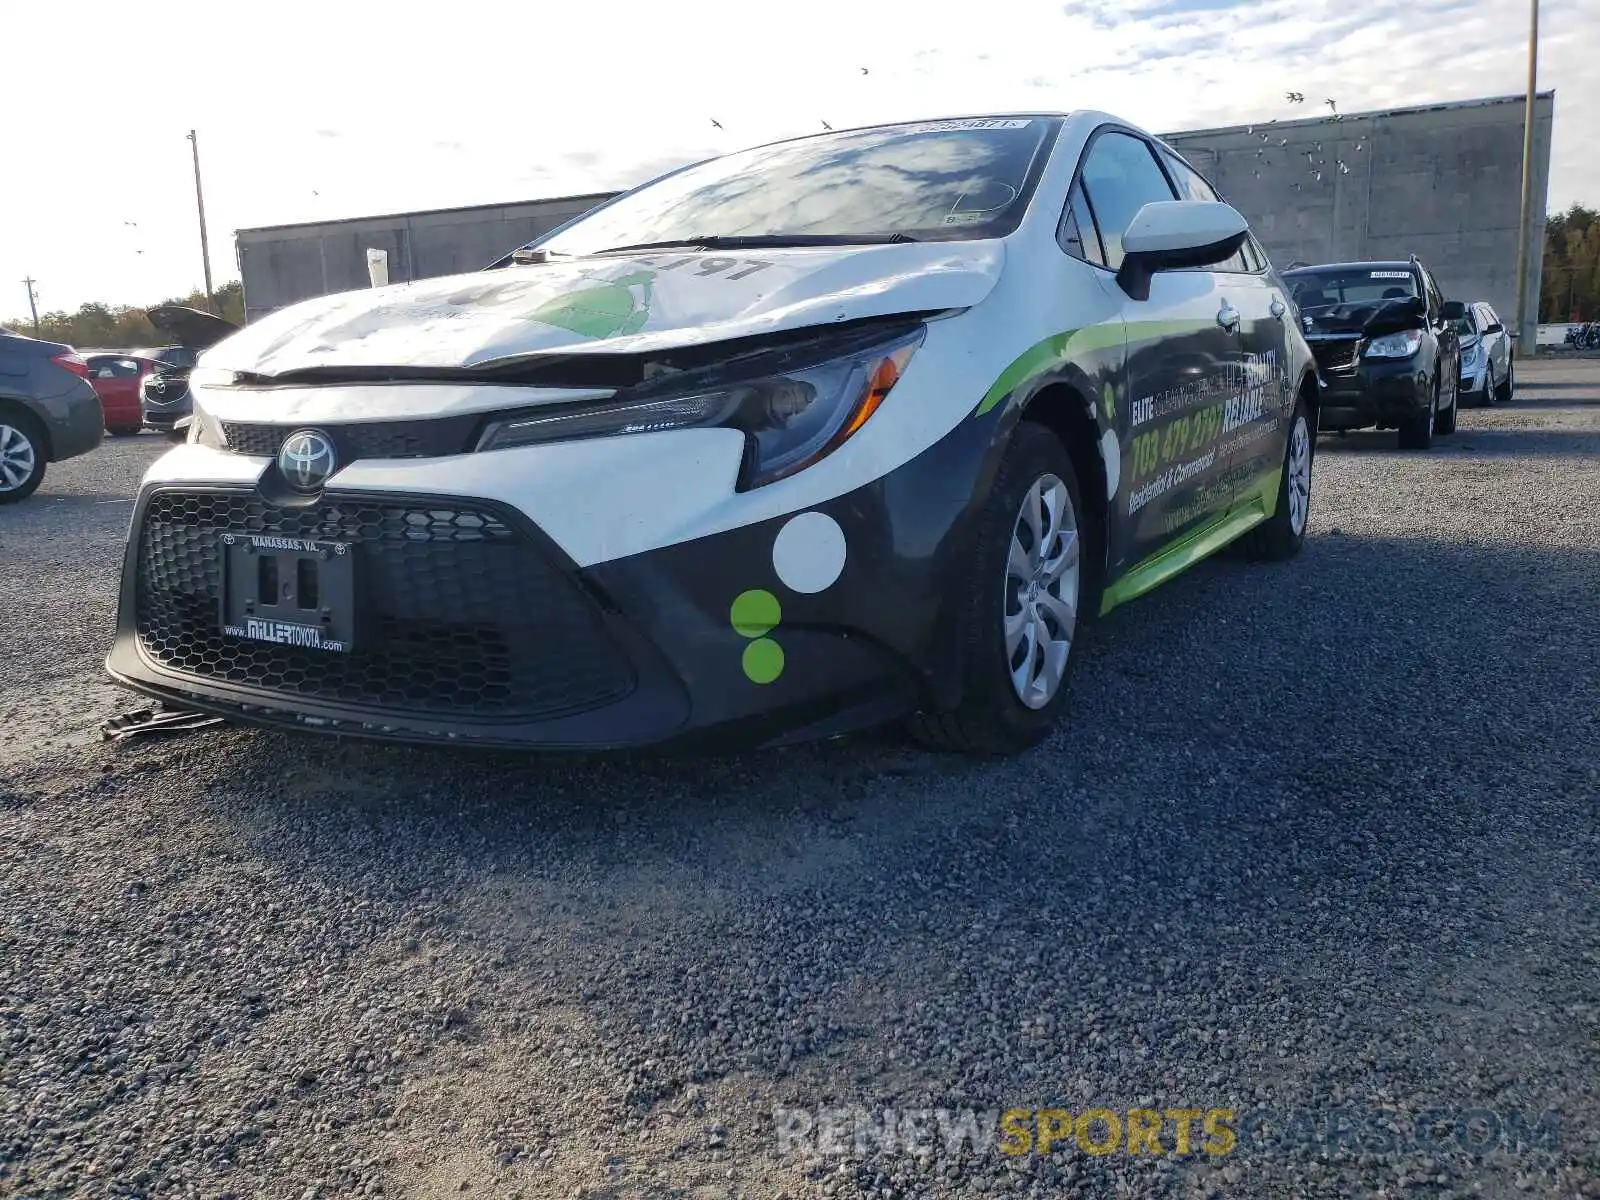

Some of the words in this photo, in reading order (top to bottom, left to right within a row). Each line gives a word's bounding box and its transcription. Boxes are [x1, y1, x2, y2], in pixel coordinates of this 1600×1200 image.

[1131, 395, 1155, 427] ELITE
[1222, 388, 1264, 434] RELIABLE
[1131, 428, 1160, 482] 703
[1162, 415, 1191, 463] 479
[1128, 475, 1167, 517] Residential
[1173, 448, 1216, 486] Commercial
